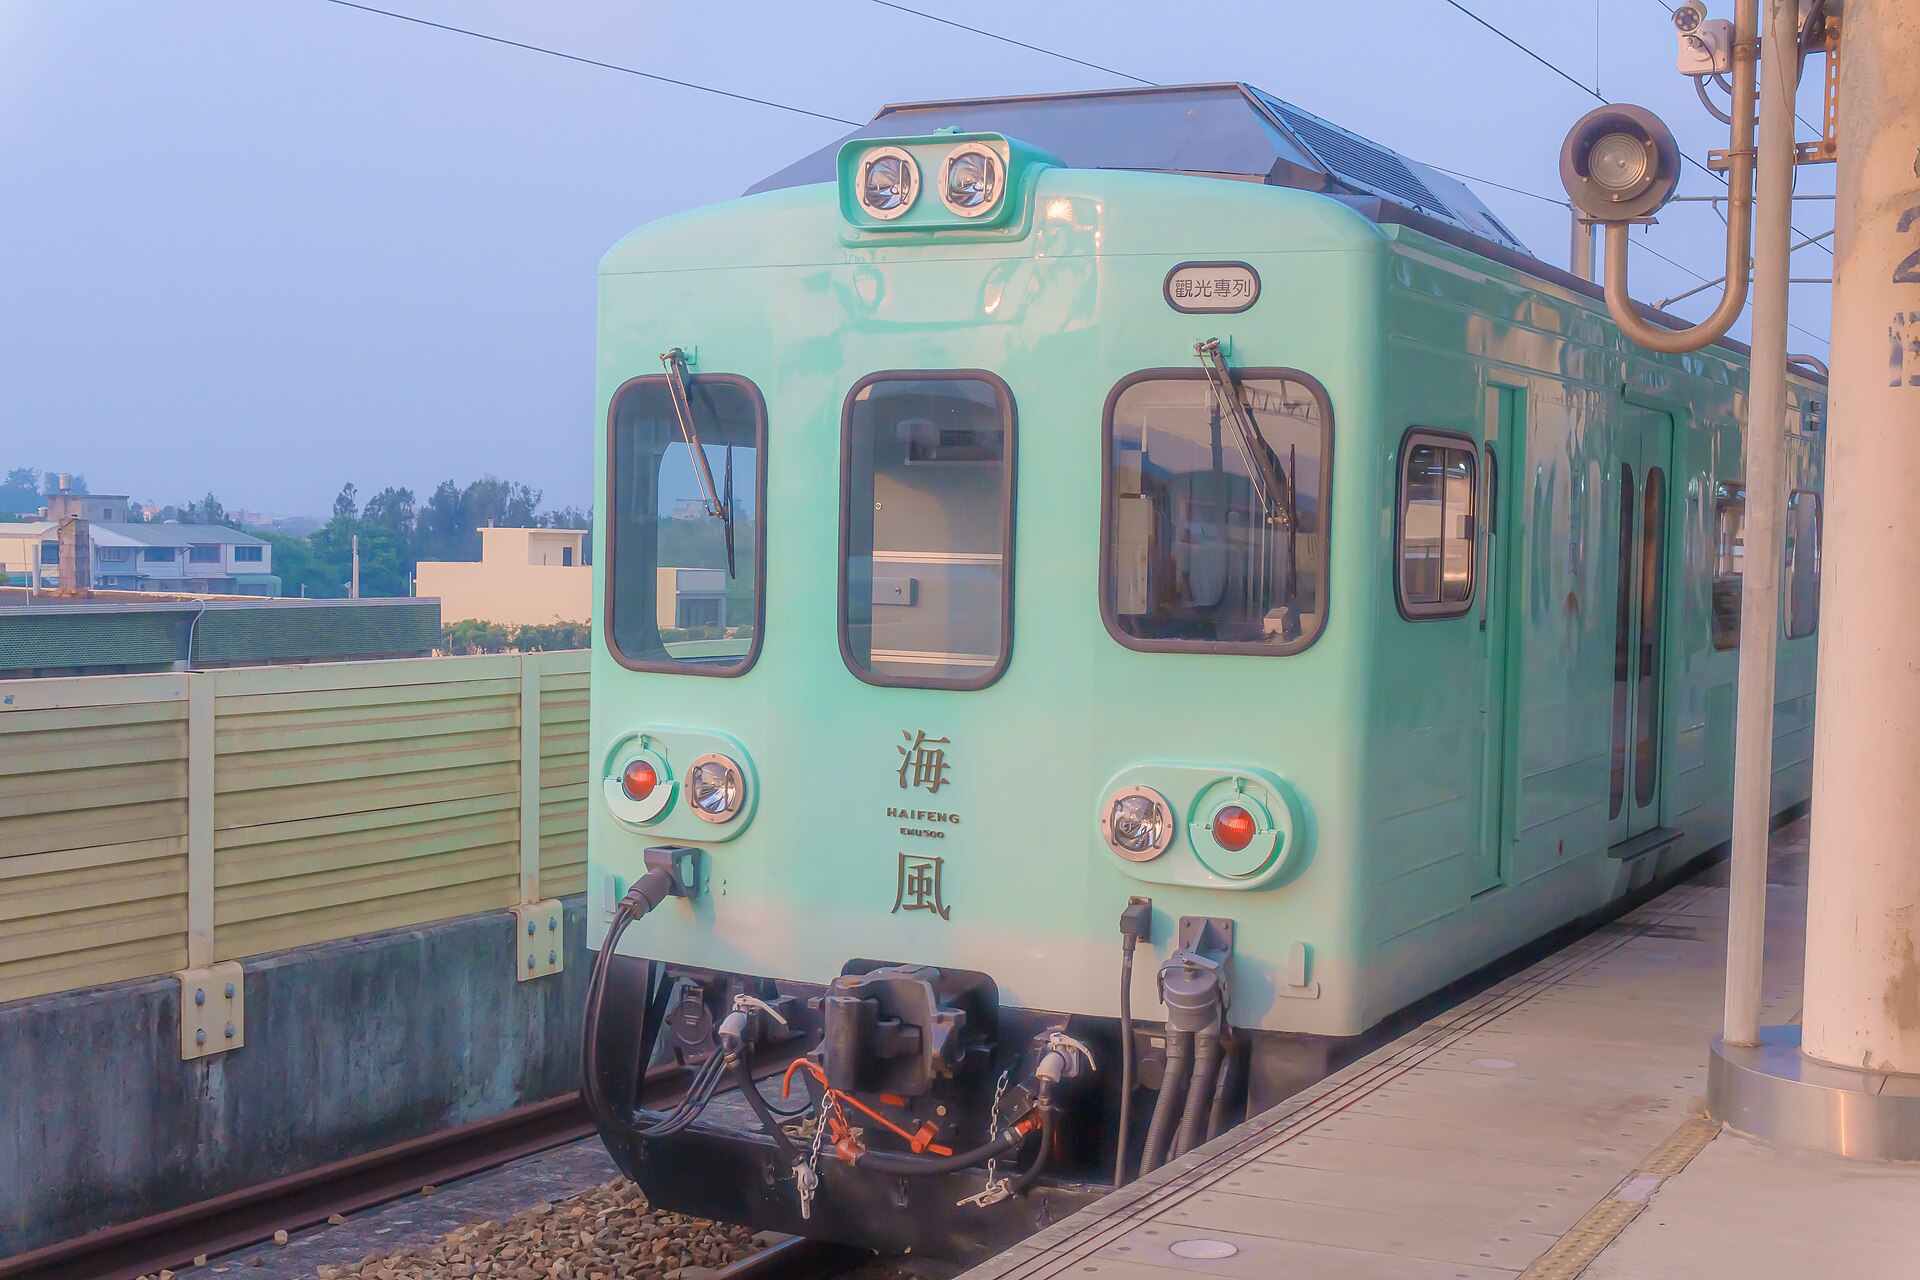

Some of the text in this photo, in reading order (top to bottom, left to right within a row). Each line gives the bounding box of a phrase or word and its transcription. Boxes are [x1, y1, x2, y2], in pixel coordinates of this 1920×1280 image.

[1175, 278, 1251, 298] 觀光專列
[896, 729, 951, 794] 海
[886, 807, 960, 824] HAIFENG
[900, 827, 945, 839] EMU500
[891, 851, 951, 921] 風
